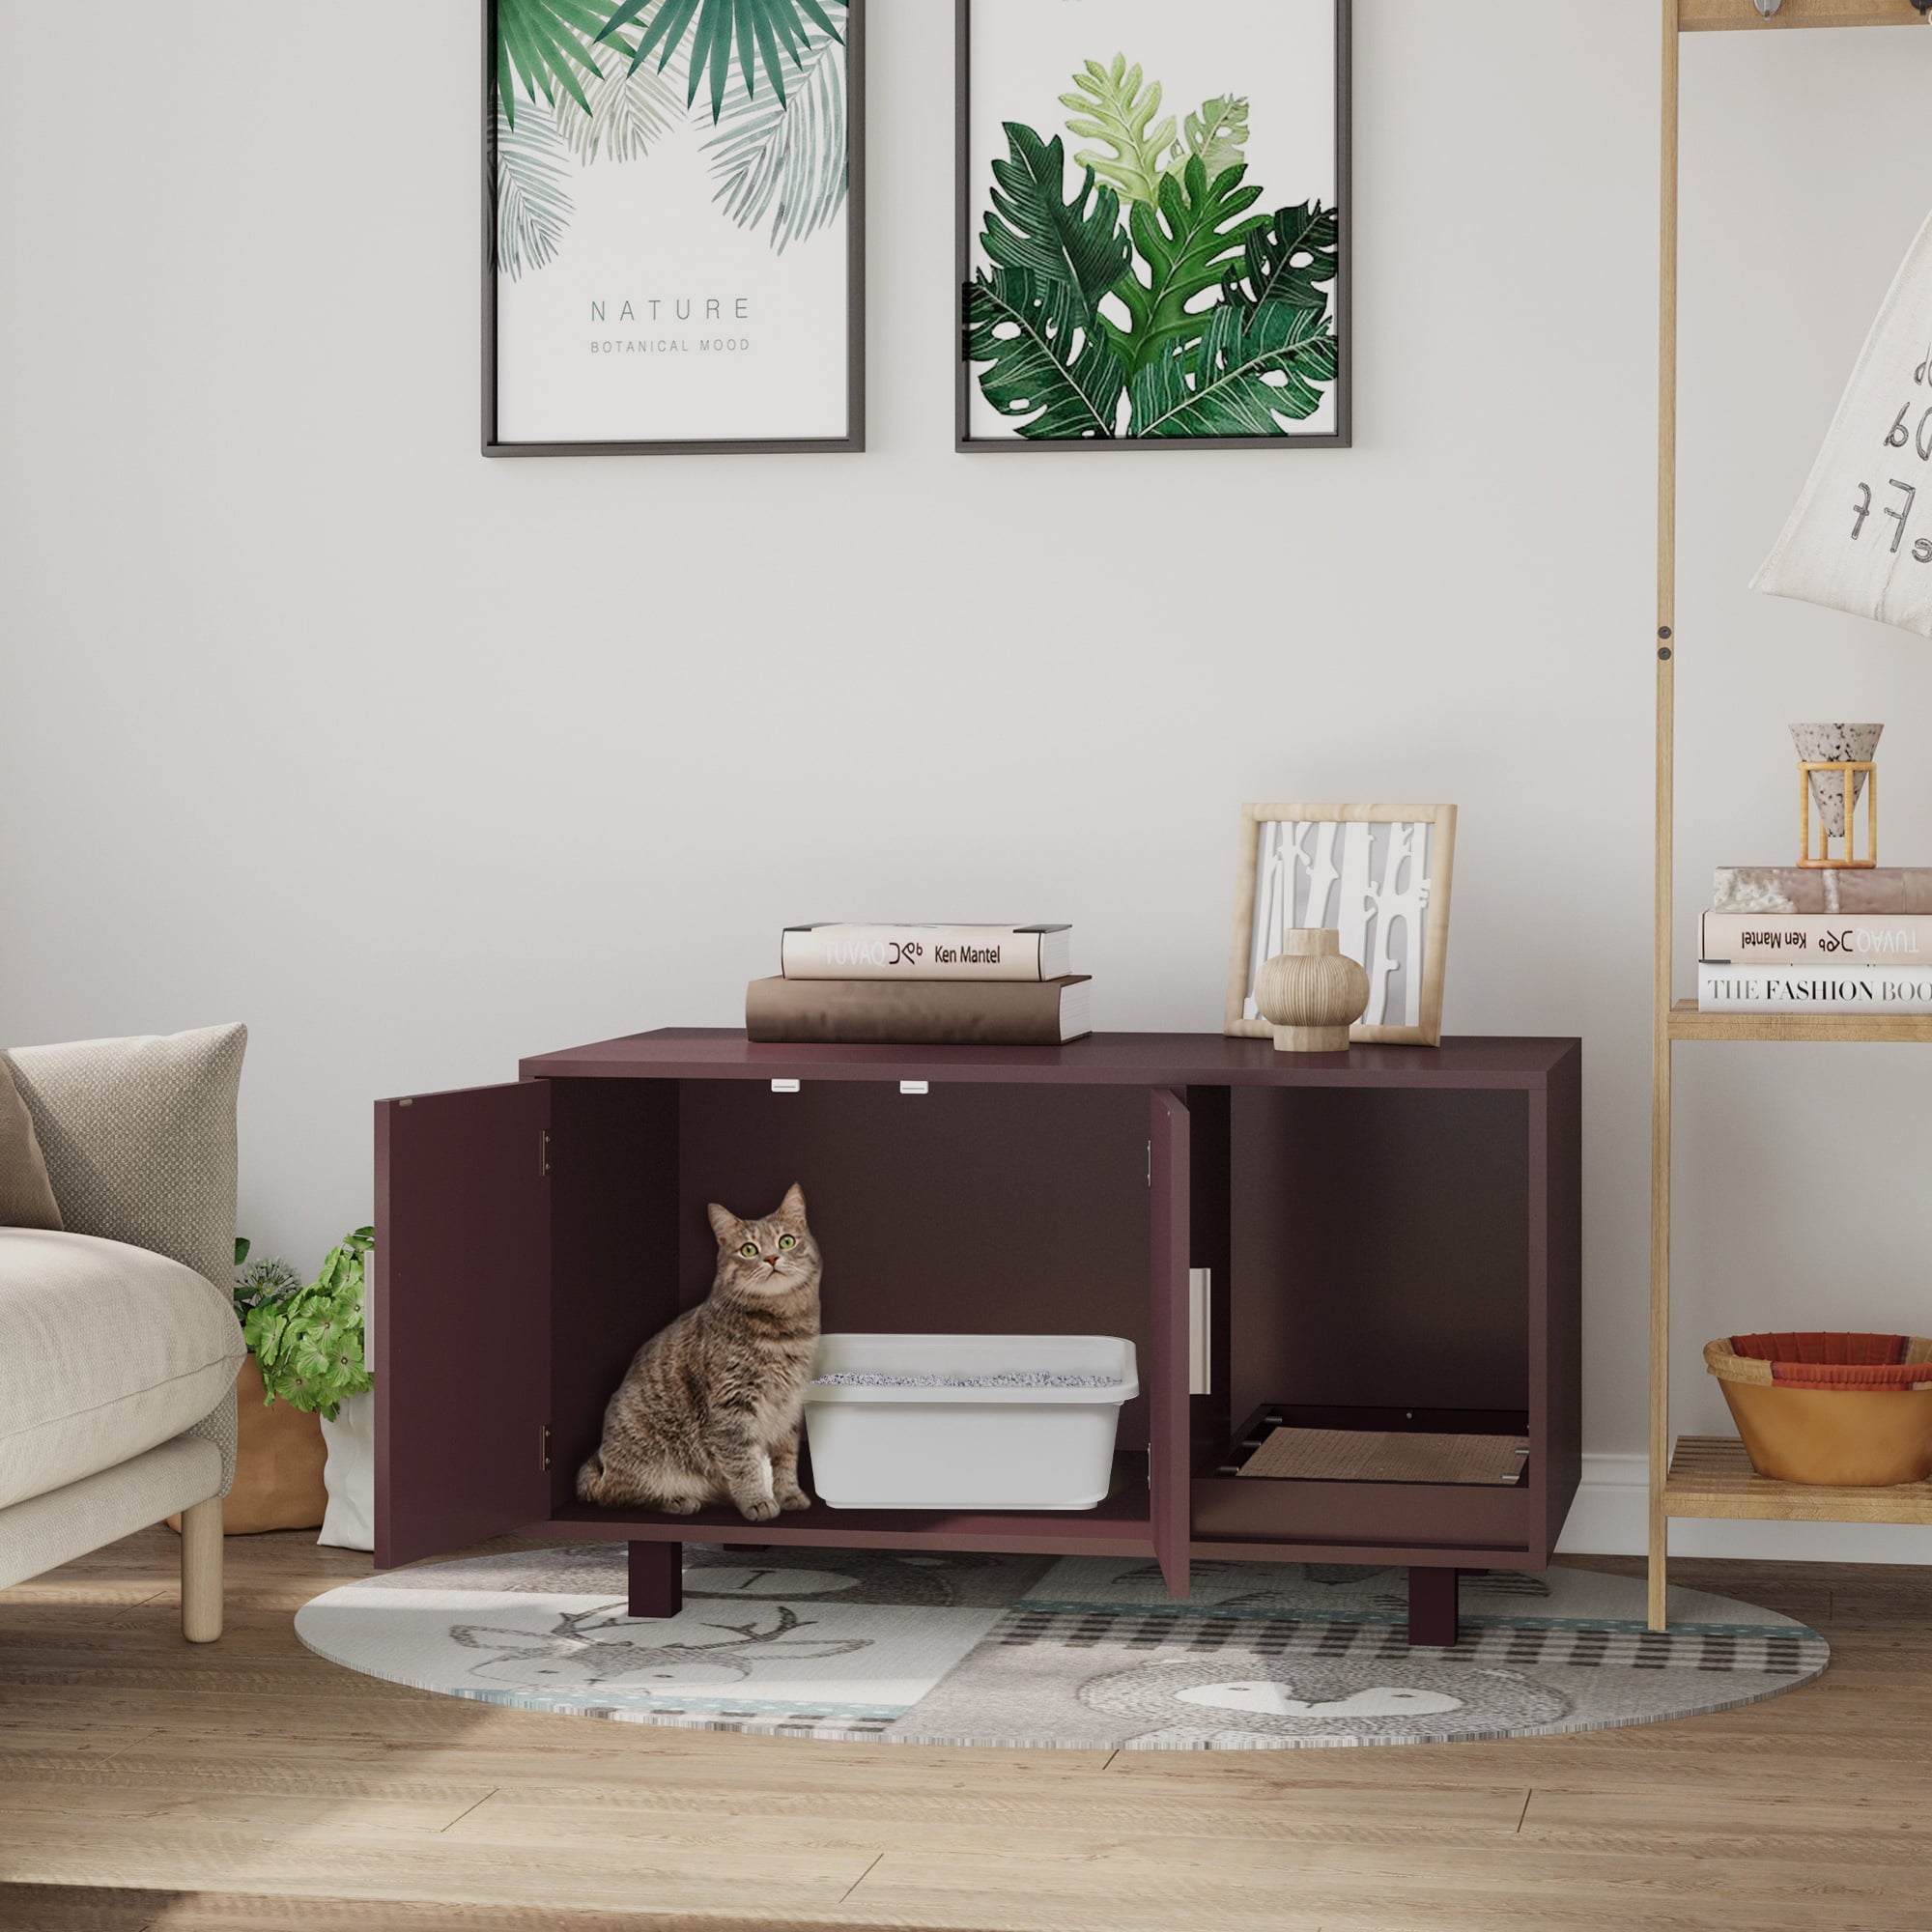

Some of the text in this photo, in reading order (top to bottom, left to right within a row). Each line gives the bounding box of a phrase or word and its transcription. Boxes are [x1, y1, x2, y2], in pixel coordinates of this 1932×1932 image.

[591, 298, 749, 322] NATURE
[590, 338, 750, 354] BOTANICAL MOOD
[1742, 931, 1781, 950] Mantel
[1784, 932, 1806, 949] Ken
[935, 946, 956, 963] Ken
[960, 945, 1001, 963] Mantel
[1708, 980, 1759, 1000] THE
[1766, 980, 1874, 1001] FASHION
